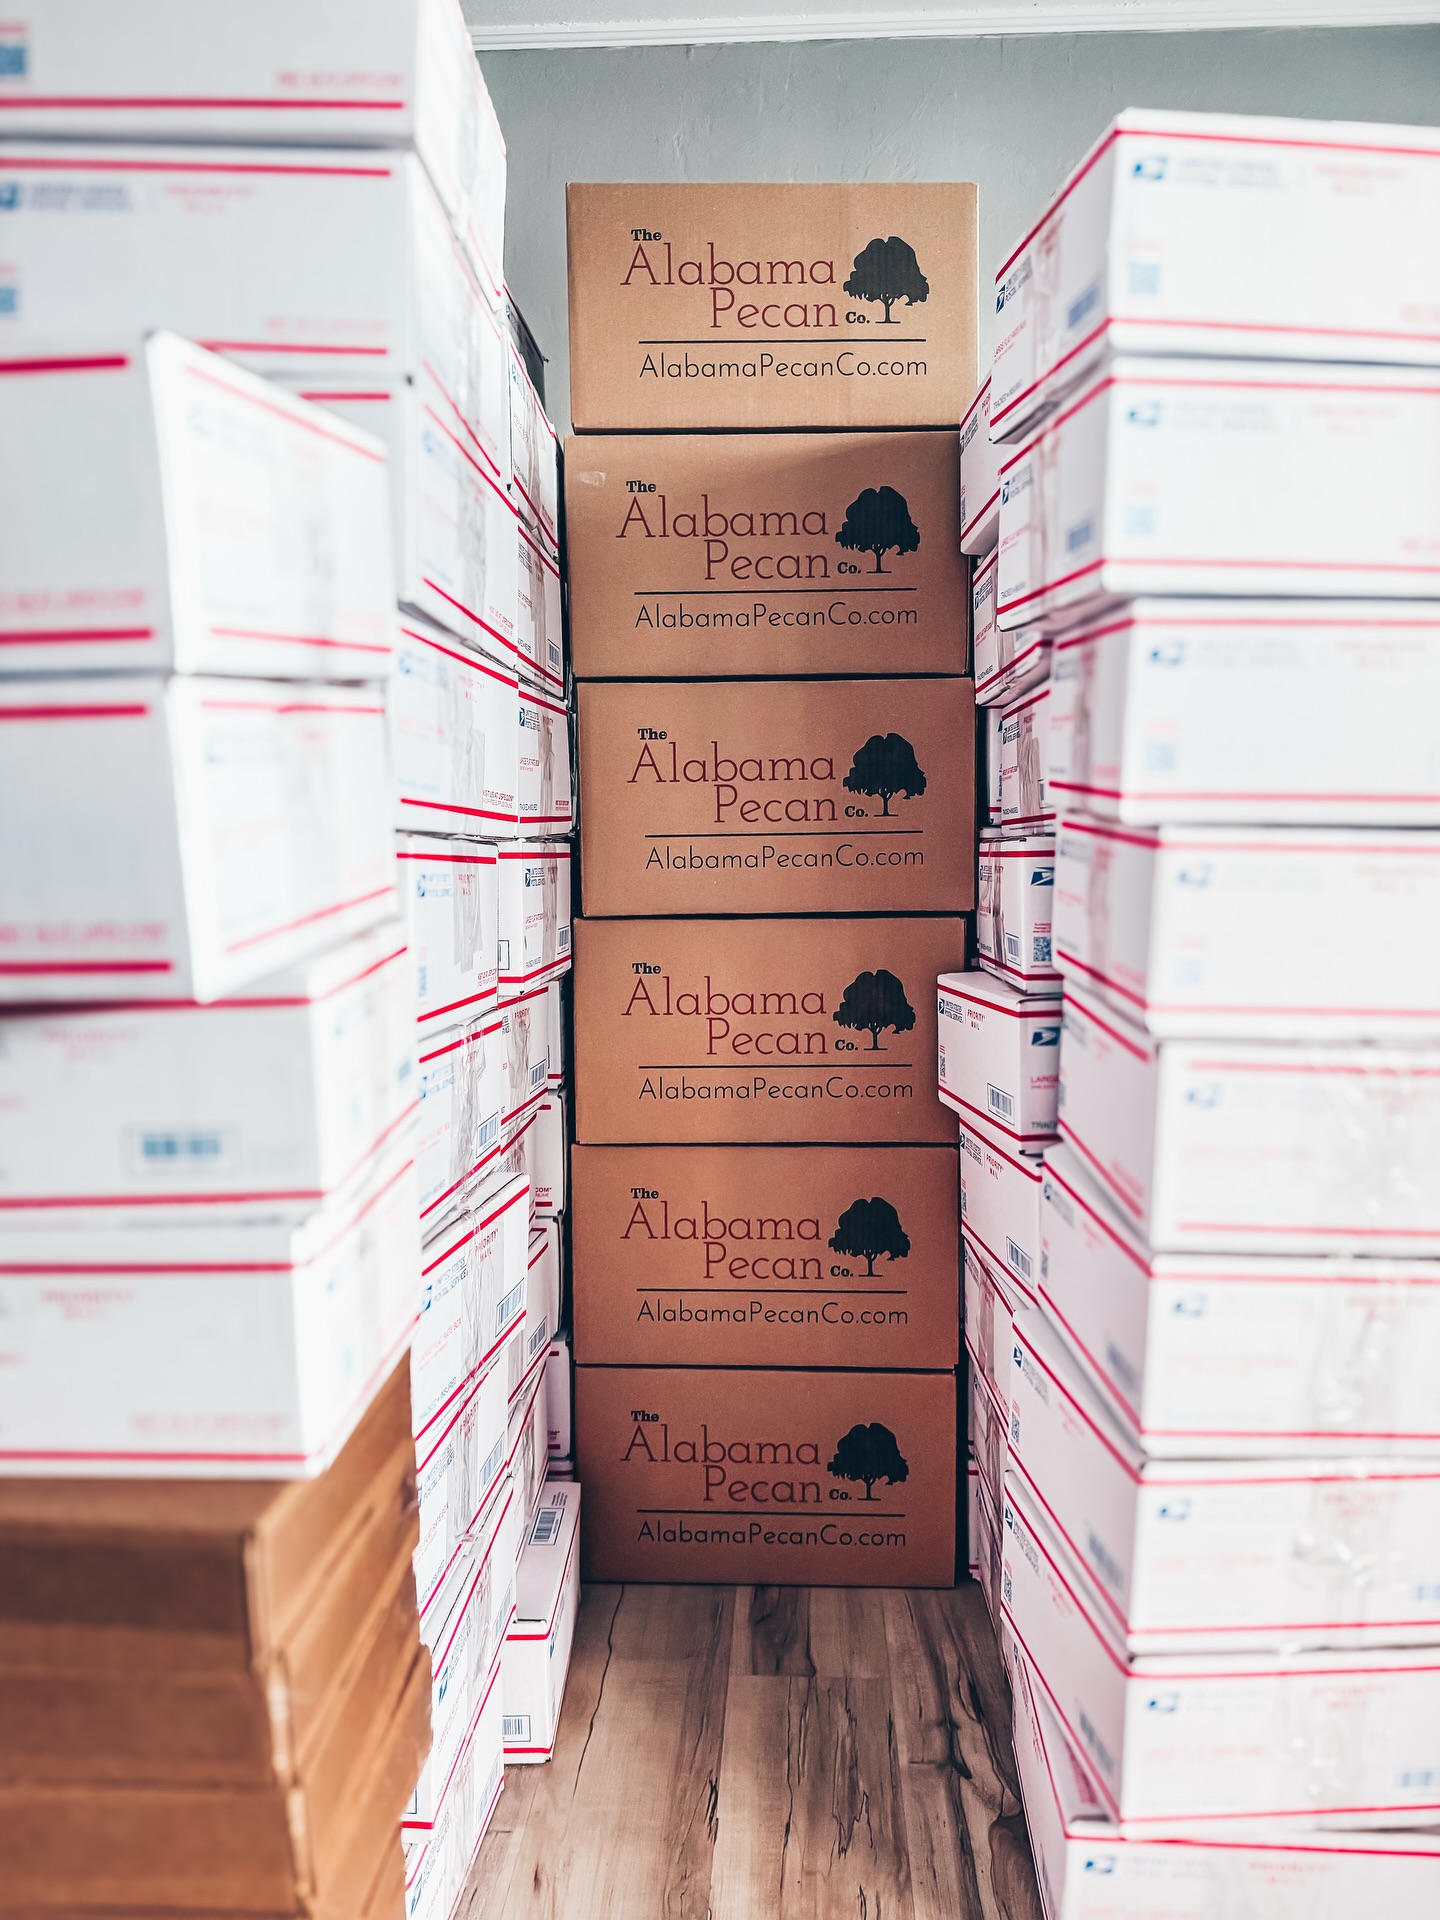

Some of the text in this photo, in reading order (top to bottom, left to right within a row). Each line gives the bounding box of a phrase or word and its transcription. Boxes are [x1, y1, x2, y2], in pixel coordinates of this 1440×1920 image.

[631, 229, 662, 241] The
[620, 242, 836, 285] Alabama
[709, 287, 870, 328] Pecan Co.
[639, 352, 926, 378] AlabamaPecanCo.com
[626, 480, 656, 493] The
[616, 494, 829, 538] Alabama
[704, 539, 861, 580] Pecan Co.
[635, 602, 917, 628] AlabamaPecanCo.com
[638, 728, 667, 740] The
[627, 741, 836, 783] Alabama
[714, 784, 868, 823] Pecan Co.
[646, 844, 923, 869] AlabamaPecanCo.com
[632, 963, 661, 975] The
[621, 976, 827, 1016] Alabama
[706, 1017, 858, 1055] Pecan Co.
[639, 1076, 912, 1100] AlabamaPecanCo.com
[631, 1188, 659, 1200] The
[620, 1201, 822, 1240] Alabama
[703, 1241, 853, 1280] Pecan Co.
[637, 1299, 907, 1324] AlabamaPecanCo.com
[631, 1410, 659, 1422] The
[620, 1424, 820, 1464] Alabama
[703, 1465, 852, 1503] Pecan Co.
[637, 1520, 906, 1546] AlabamaPecanCo.com
